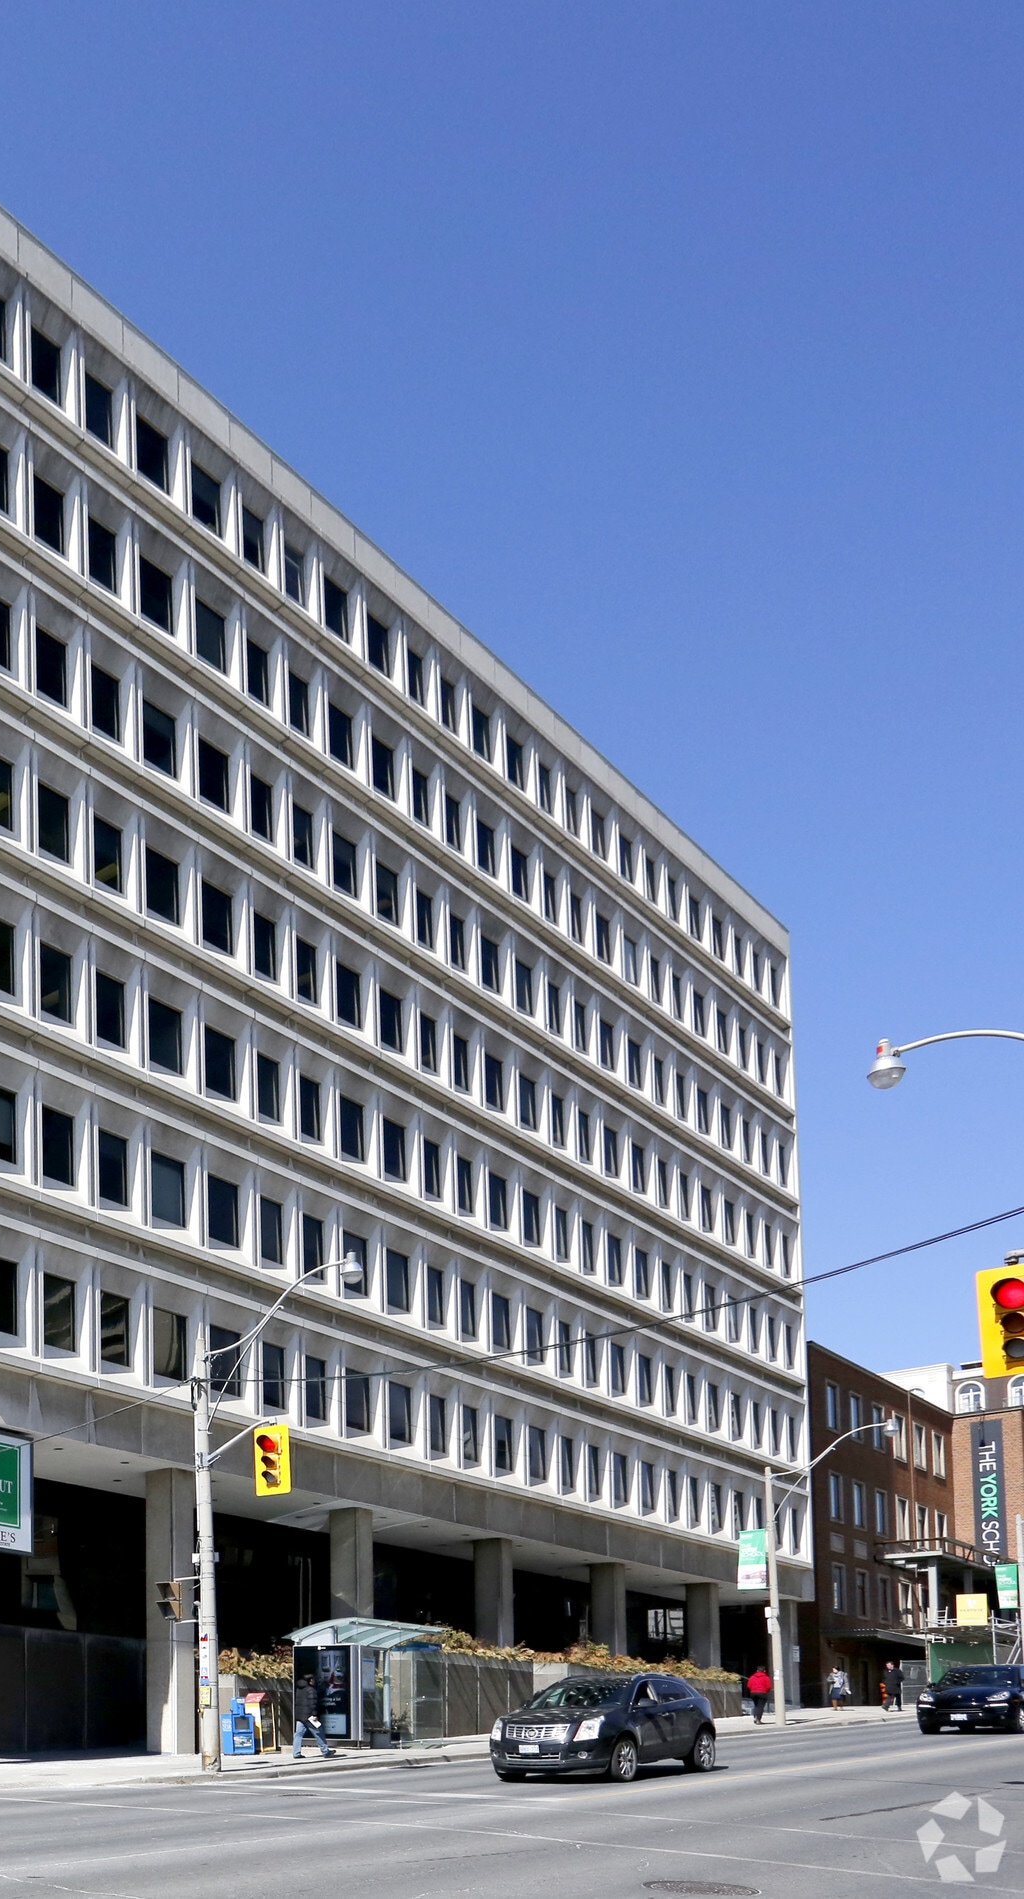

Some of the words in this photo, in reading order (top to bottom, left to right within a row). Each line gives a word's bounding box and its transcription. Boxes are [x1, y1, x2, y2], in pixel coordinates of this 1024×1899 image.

[978, 1440, 997, 1473] THE
[980, 1472, 999, 1520] YORK
[981, 1521, 1000, 1567] SCHO
